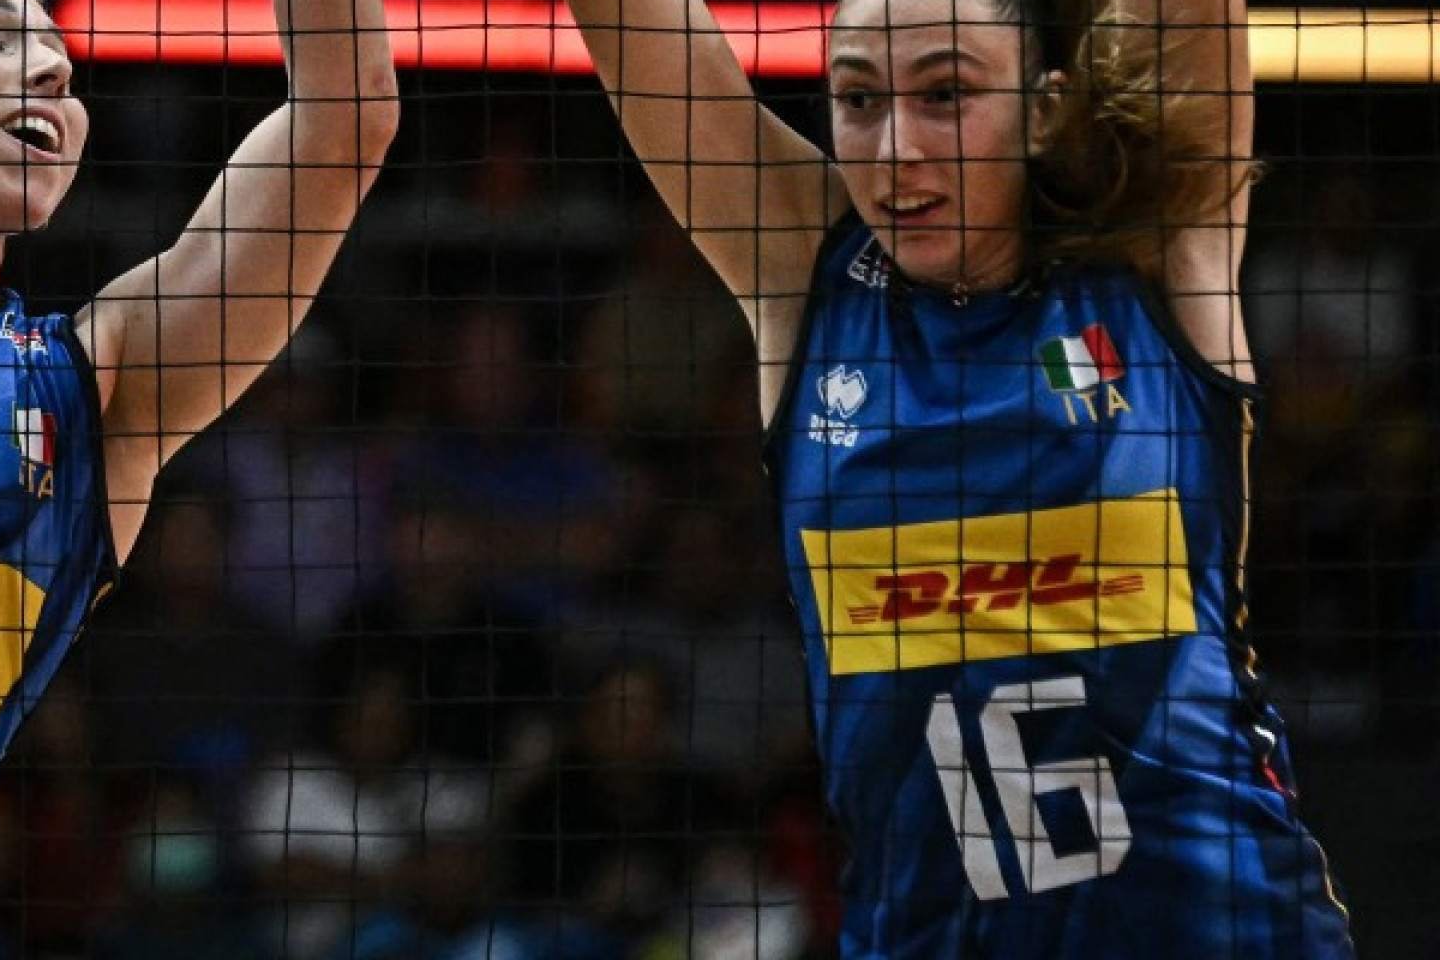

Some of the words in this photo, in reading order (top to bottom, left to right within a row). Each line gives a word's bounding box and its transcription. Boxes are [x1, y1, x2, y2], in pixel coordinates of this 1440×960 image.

[1061, 384, 1131, 425] ITA
[875, 554, 1102, 622] DHL
[925, 676, 1133, 901] 16
